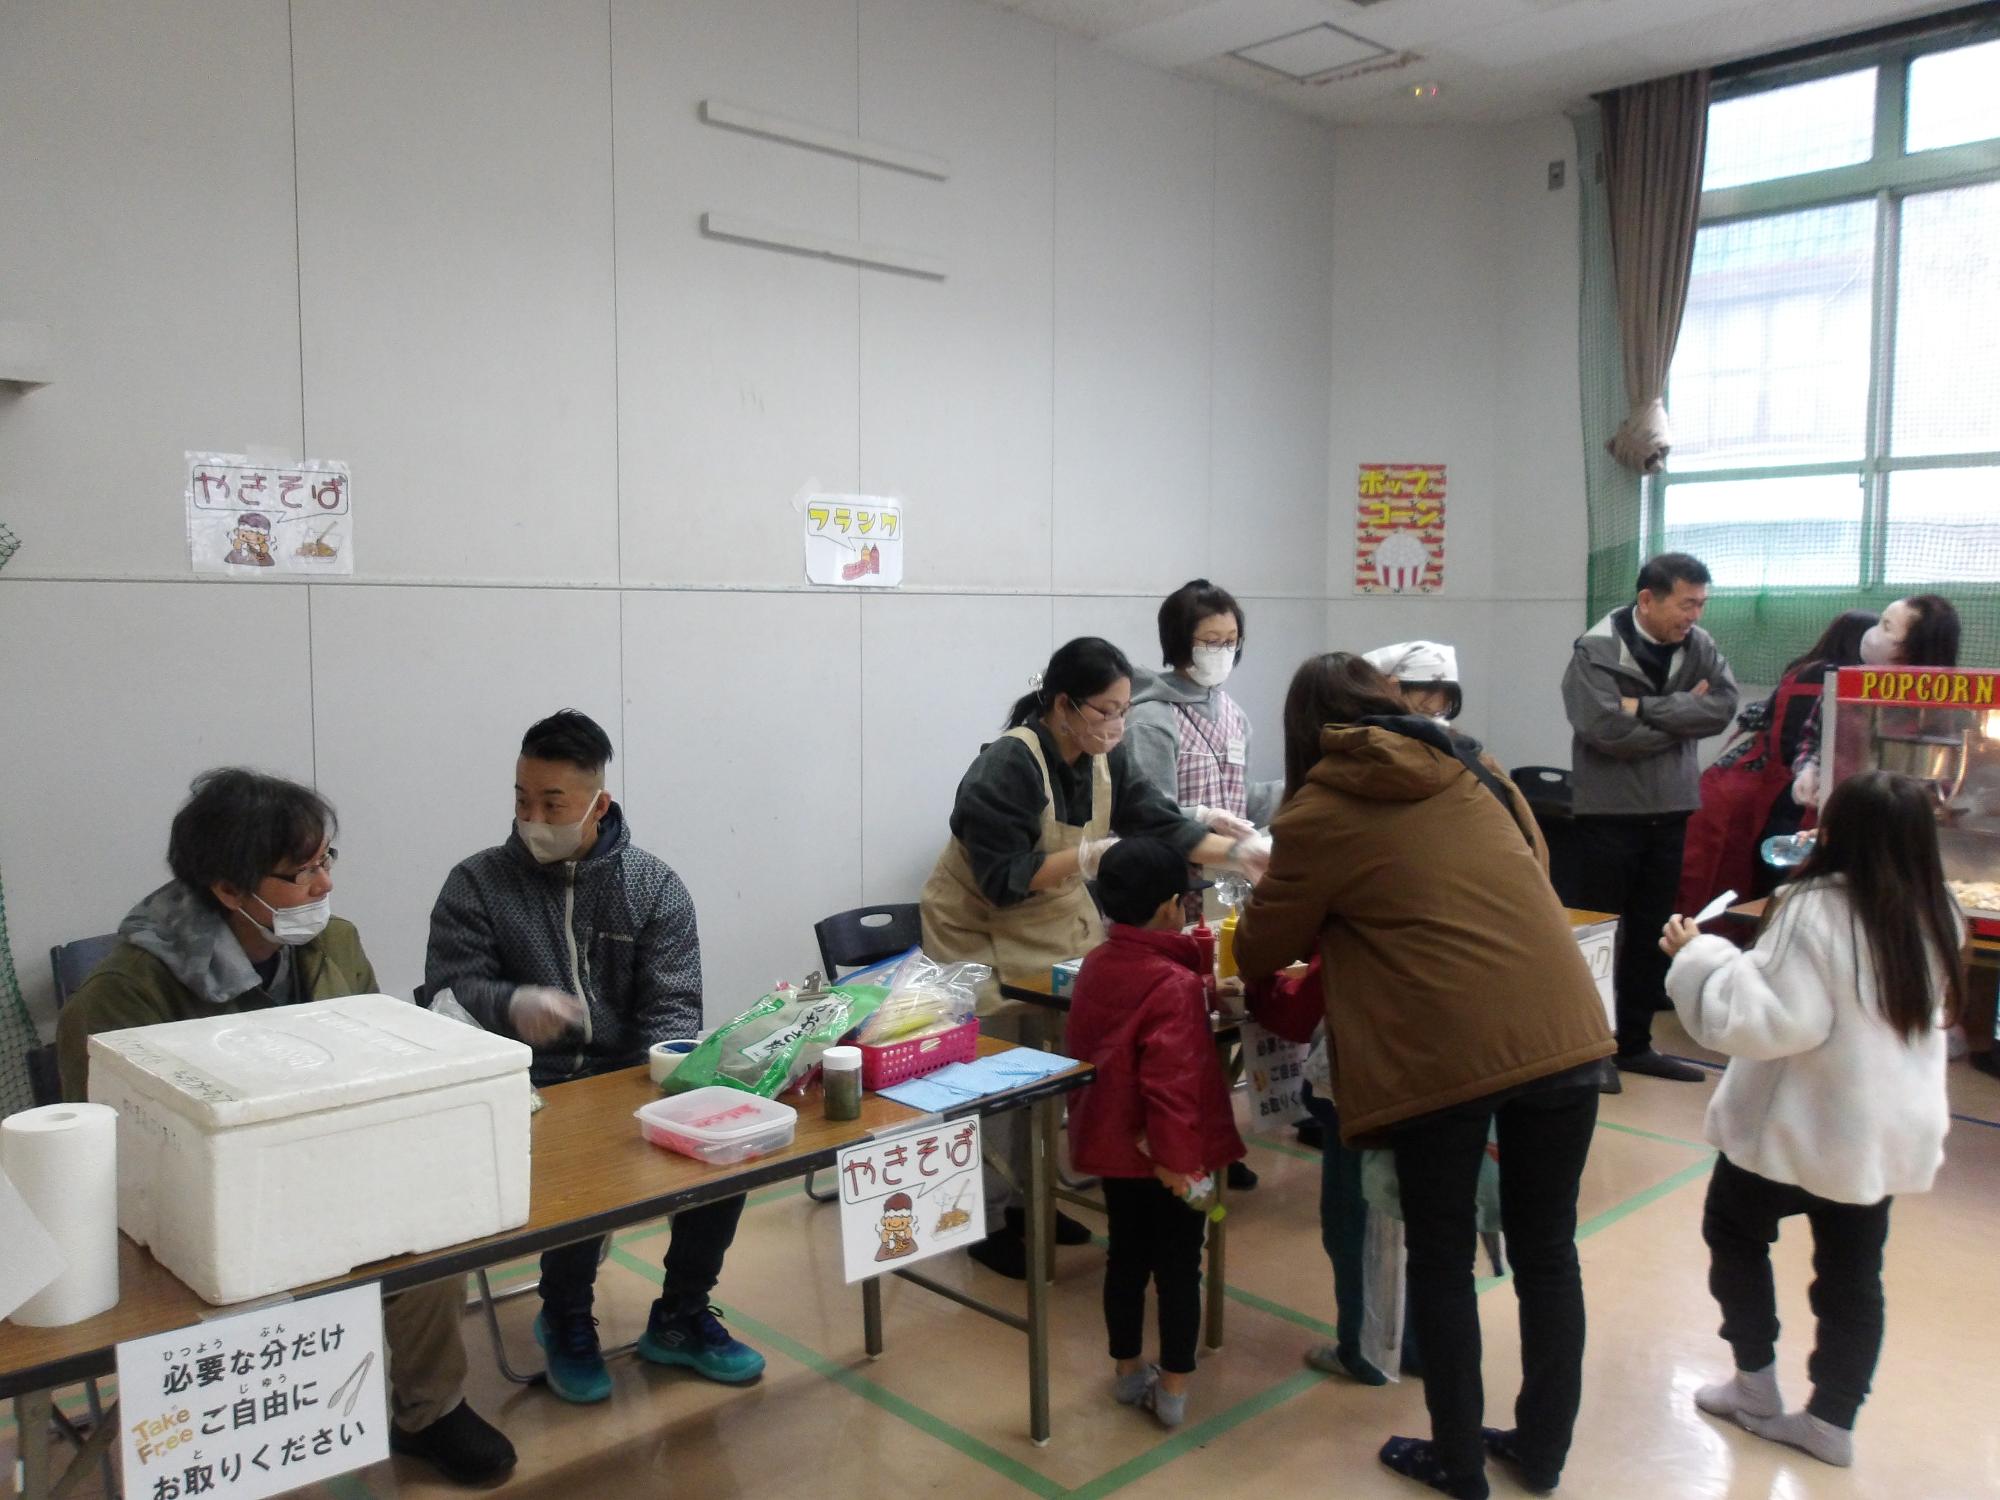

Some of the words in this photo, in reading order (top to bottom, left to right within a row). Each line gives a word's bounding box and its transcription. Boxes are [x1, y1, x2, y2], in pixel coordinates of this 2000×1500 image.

[195, 471, 347, 511] やきそば
[809, 508, 897, 536] フランク
[1368, 503, 1439, 526] コーン
[1861, 671, 1994, 705] POPCORN
[843, 1123, 977, 1196] やきそば
[162, 1338, 224, 1362] ひつよう
[260, 1323, 286, 1337] ぶん
[162, 1323, 346, 1396] 必要な分だけ
[132, 1408, 191, 1441] Take
[200, 1381, 319, 1436] ご自由に
[137, 1428, 194, 1466] Free
[153, 1421, 365, 1500] お取りください
[193, 1449, 203, 1460] と
